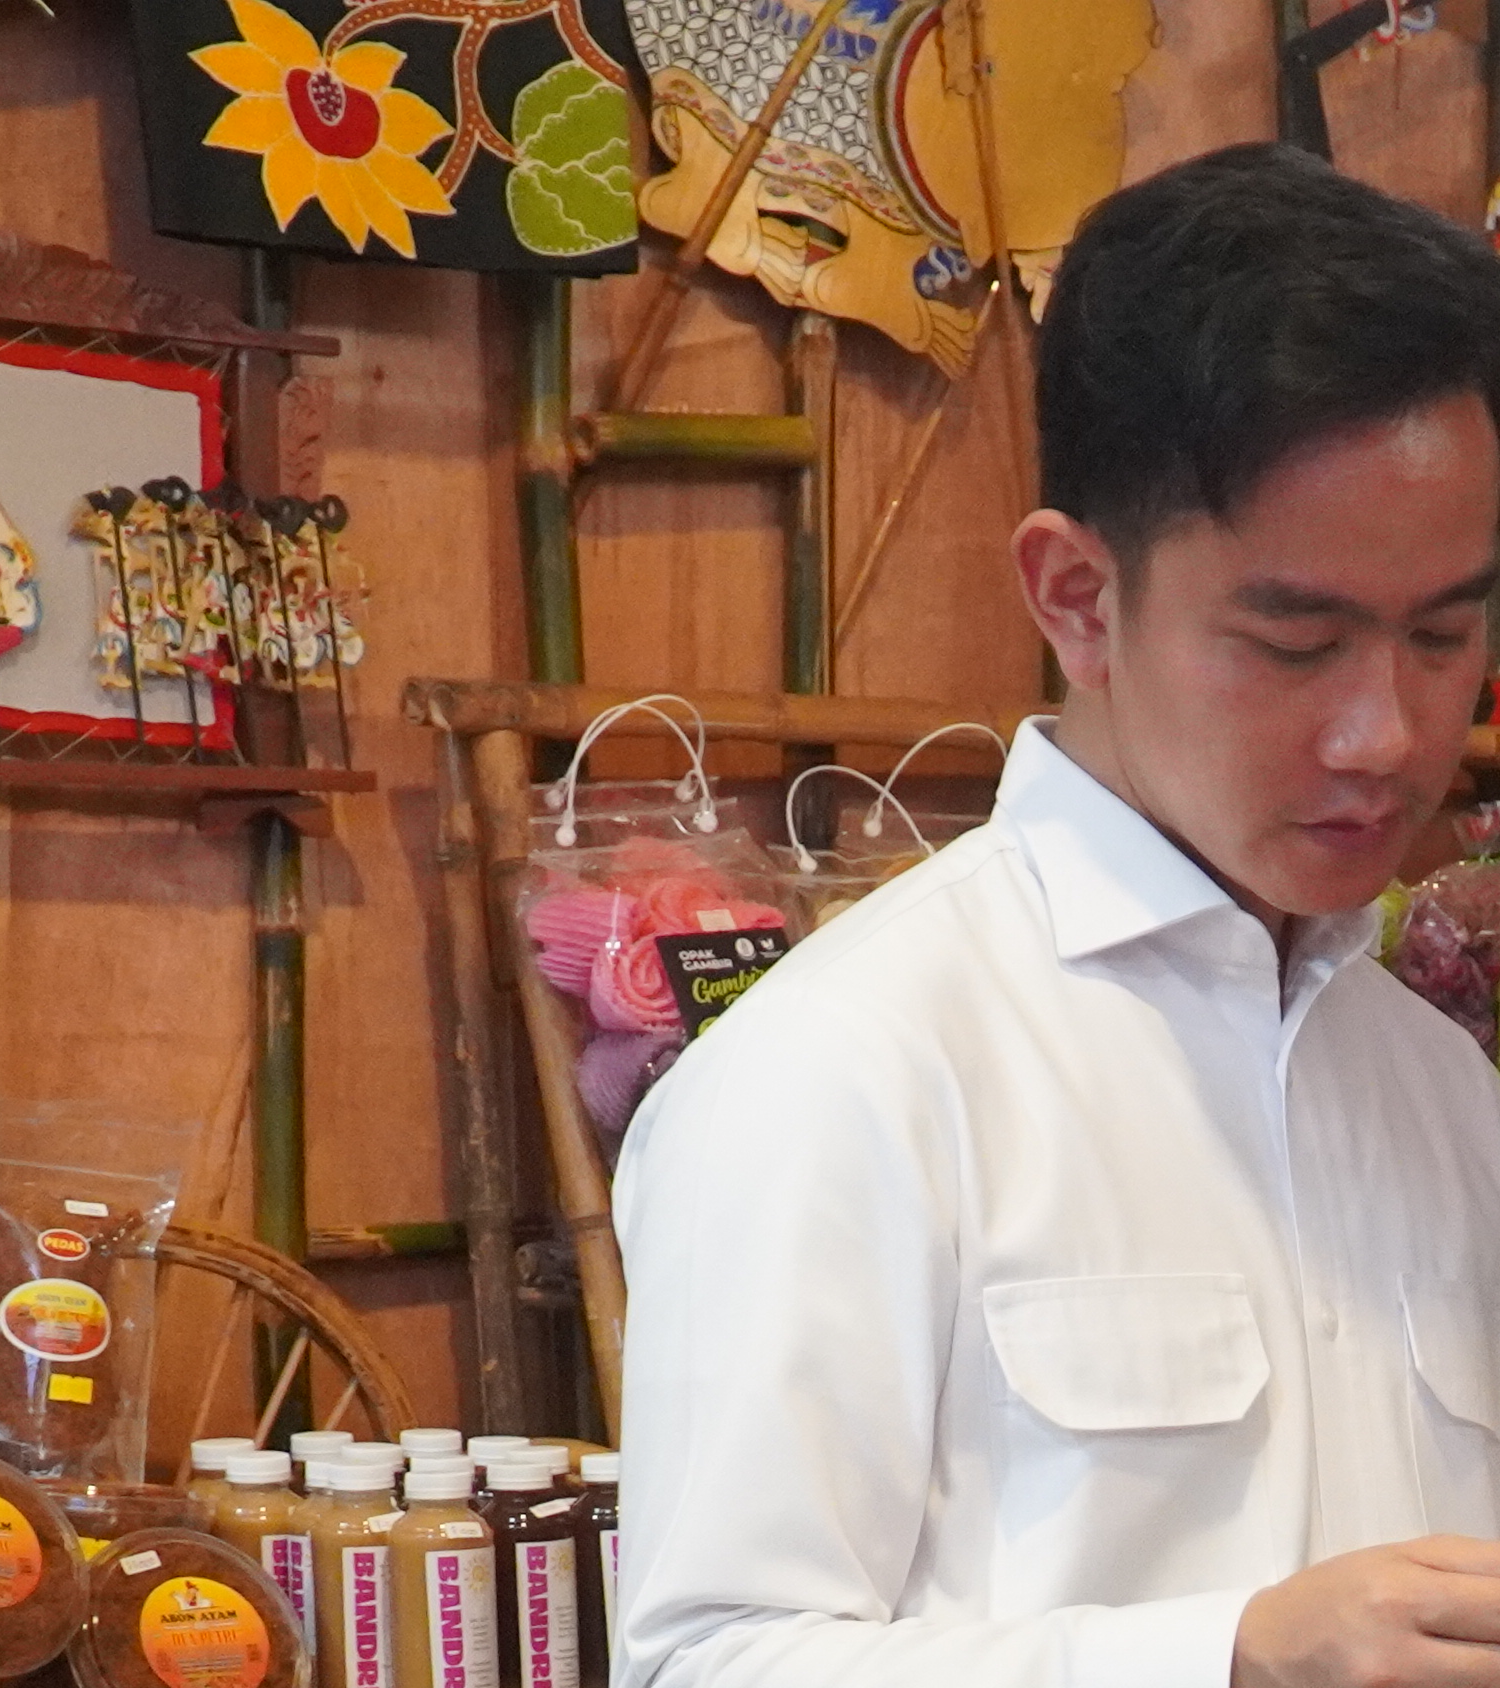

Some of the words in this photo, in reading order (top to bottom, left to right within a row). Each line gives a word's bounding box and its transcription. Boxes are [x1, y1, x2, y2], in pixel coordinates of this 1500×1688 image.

[43, 1236, 84, 1253] PEDAS
[160, 1613, 196, 1624] ABON
[200, 1609, 238, 1622] AYAM
